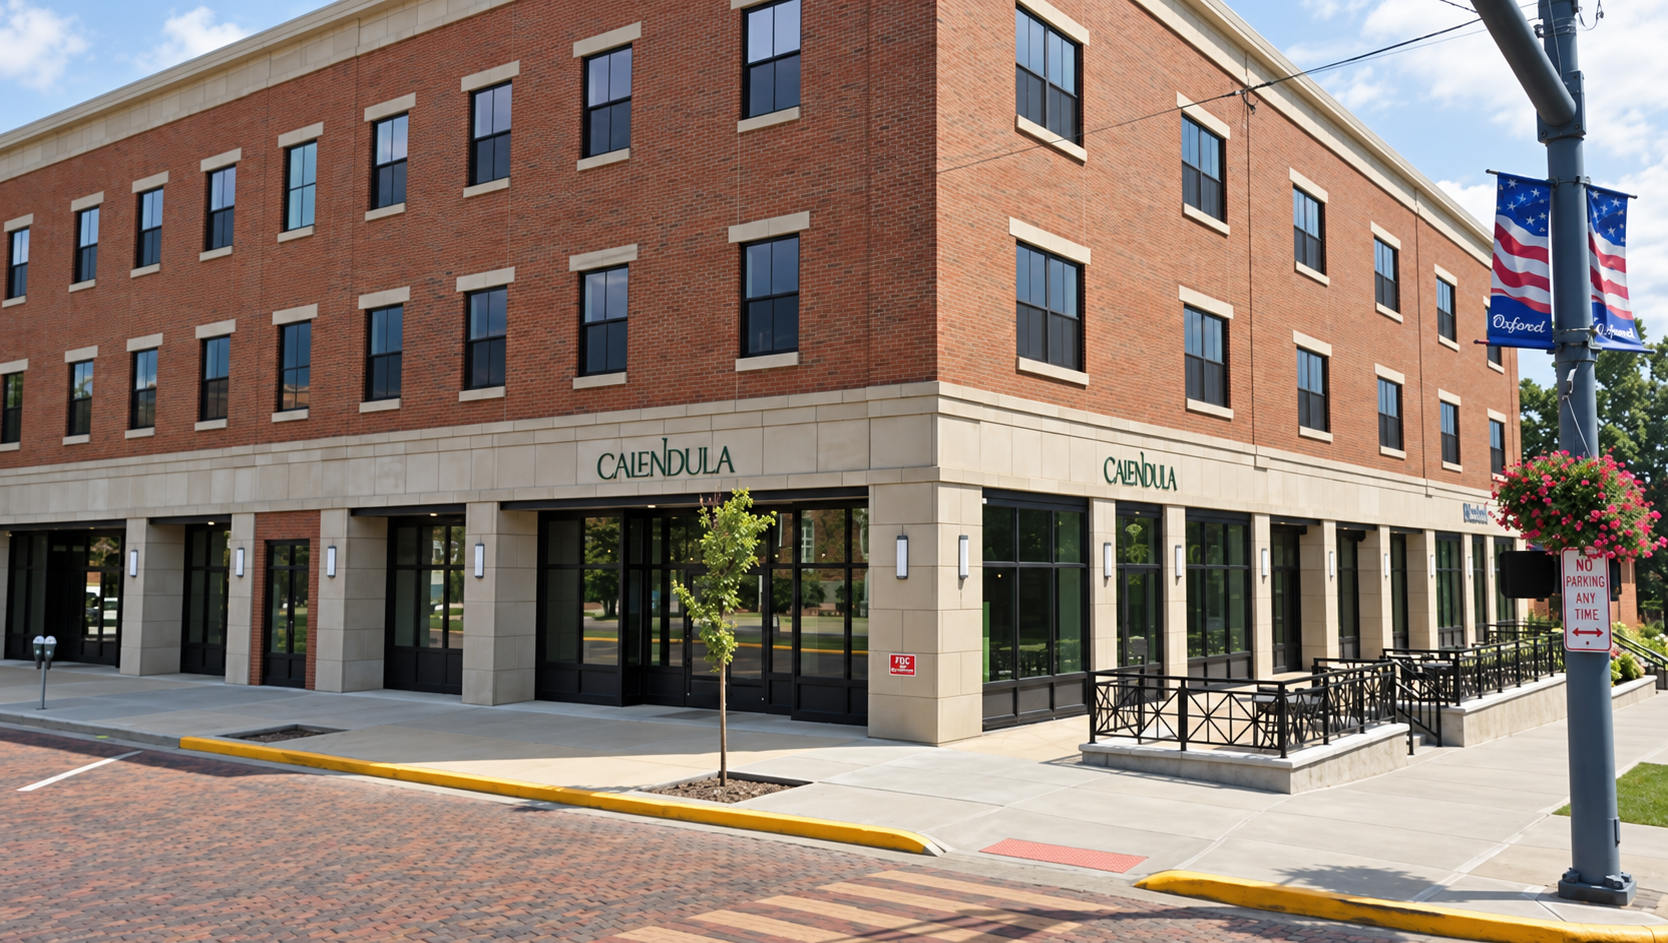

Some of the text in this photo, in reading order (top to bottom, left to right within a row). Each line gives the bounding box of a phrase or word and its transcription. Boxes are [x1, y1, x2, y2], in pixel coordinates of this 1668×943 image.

[1493, 313, 1546, 334] Oxford
[597, 437, 735, 480] CALENDULA
[1103, 451, 1177, 491] CALENDULA
[1576, 559, 1593, 572] NO
[1566, 575, 1605, 588] PARKING
[1575, 592, 1596, 604] ANY
[1574, 608, 1600, 621] TIME
